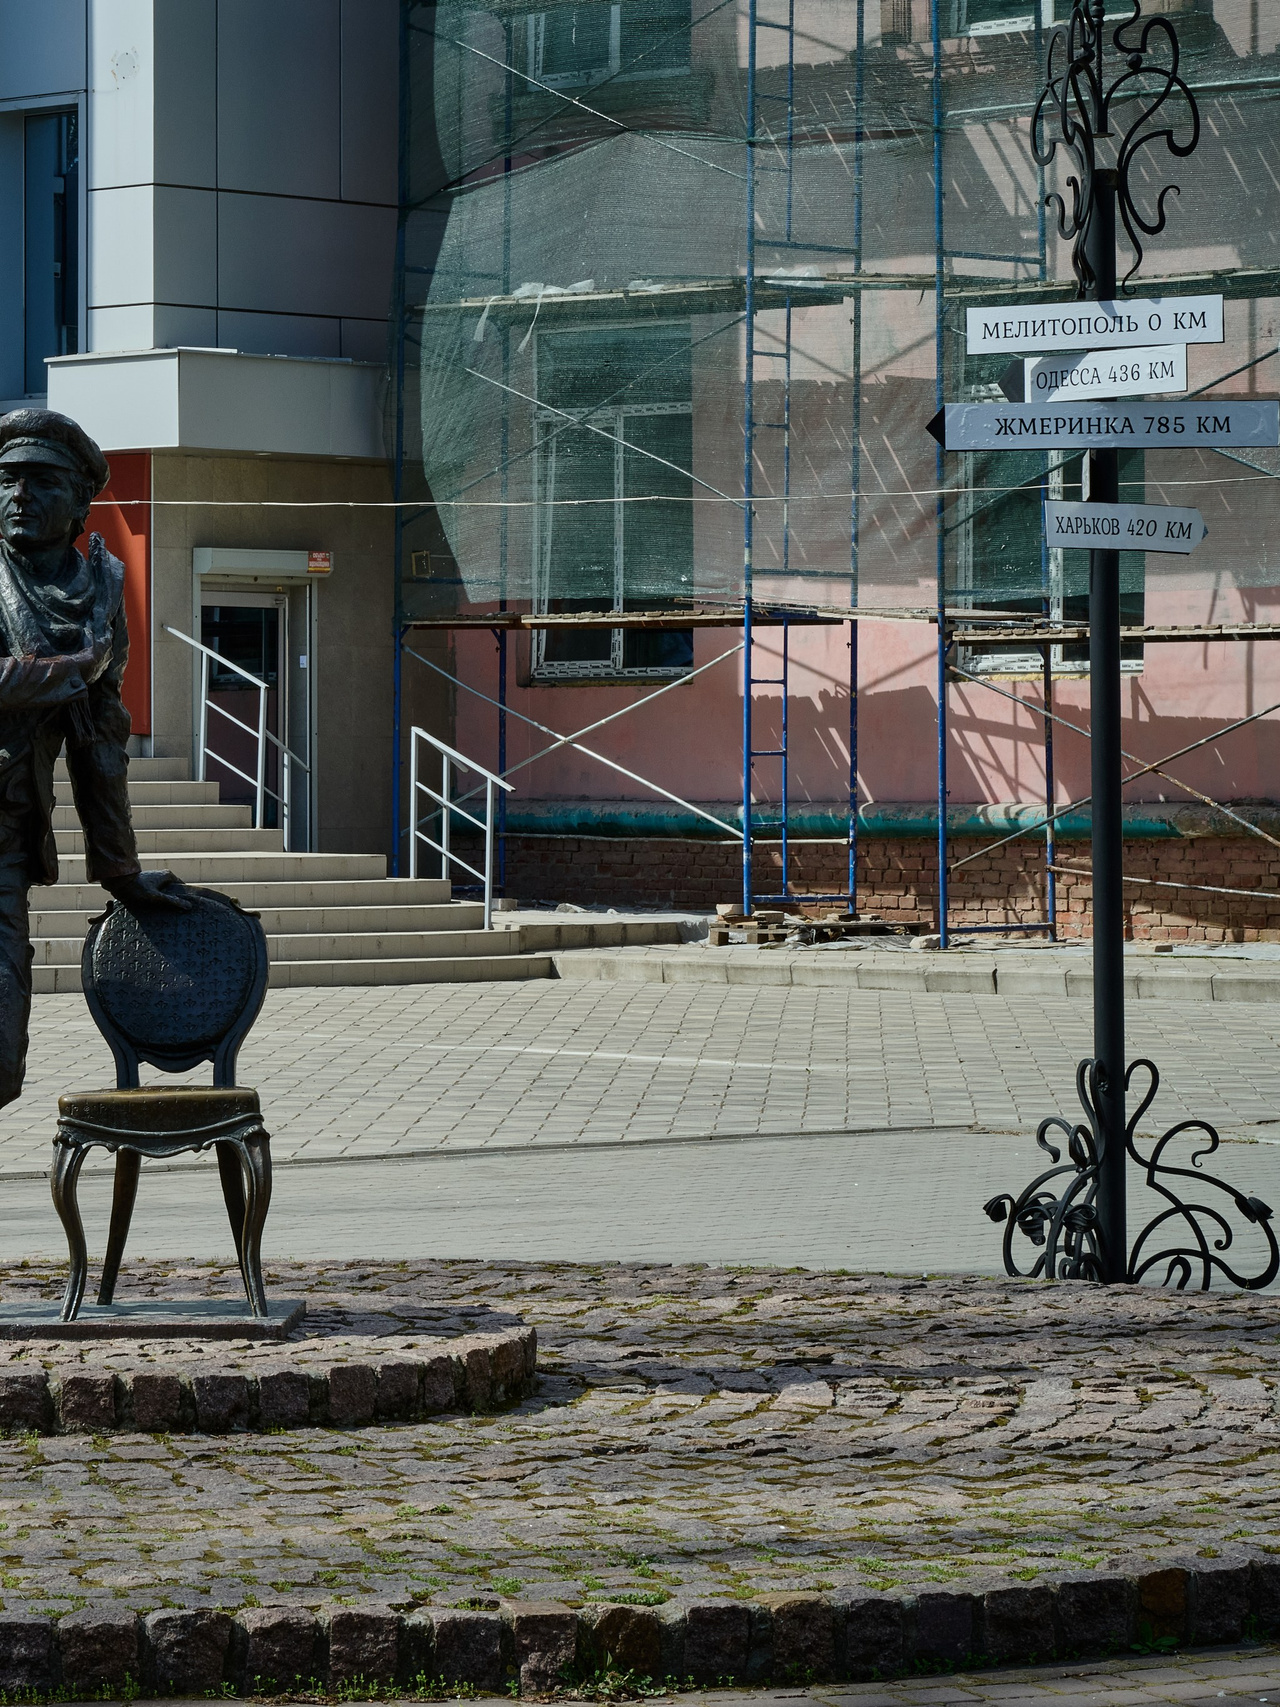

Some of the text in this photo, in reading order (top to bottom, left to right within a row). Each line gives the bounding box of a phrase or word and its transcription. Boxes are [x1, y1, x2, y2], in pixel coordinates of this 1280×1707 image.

[981, 315, 1139, 340] МЕЛИТОПОЛЬ
[1173, 311, 1208, 330] КМ
[1036, 360, 1175, 391] ОДЕССА 436 КМ
[995, 416, 1232, 436] ЖМЕРИНКА 785 КМ
[1055, 516, 1193, 540] ХАРЬКОВ 420 КМ
